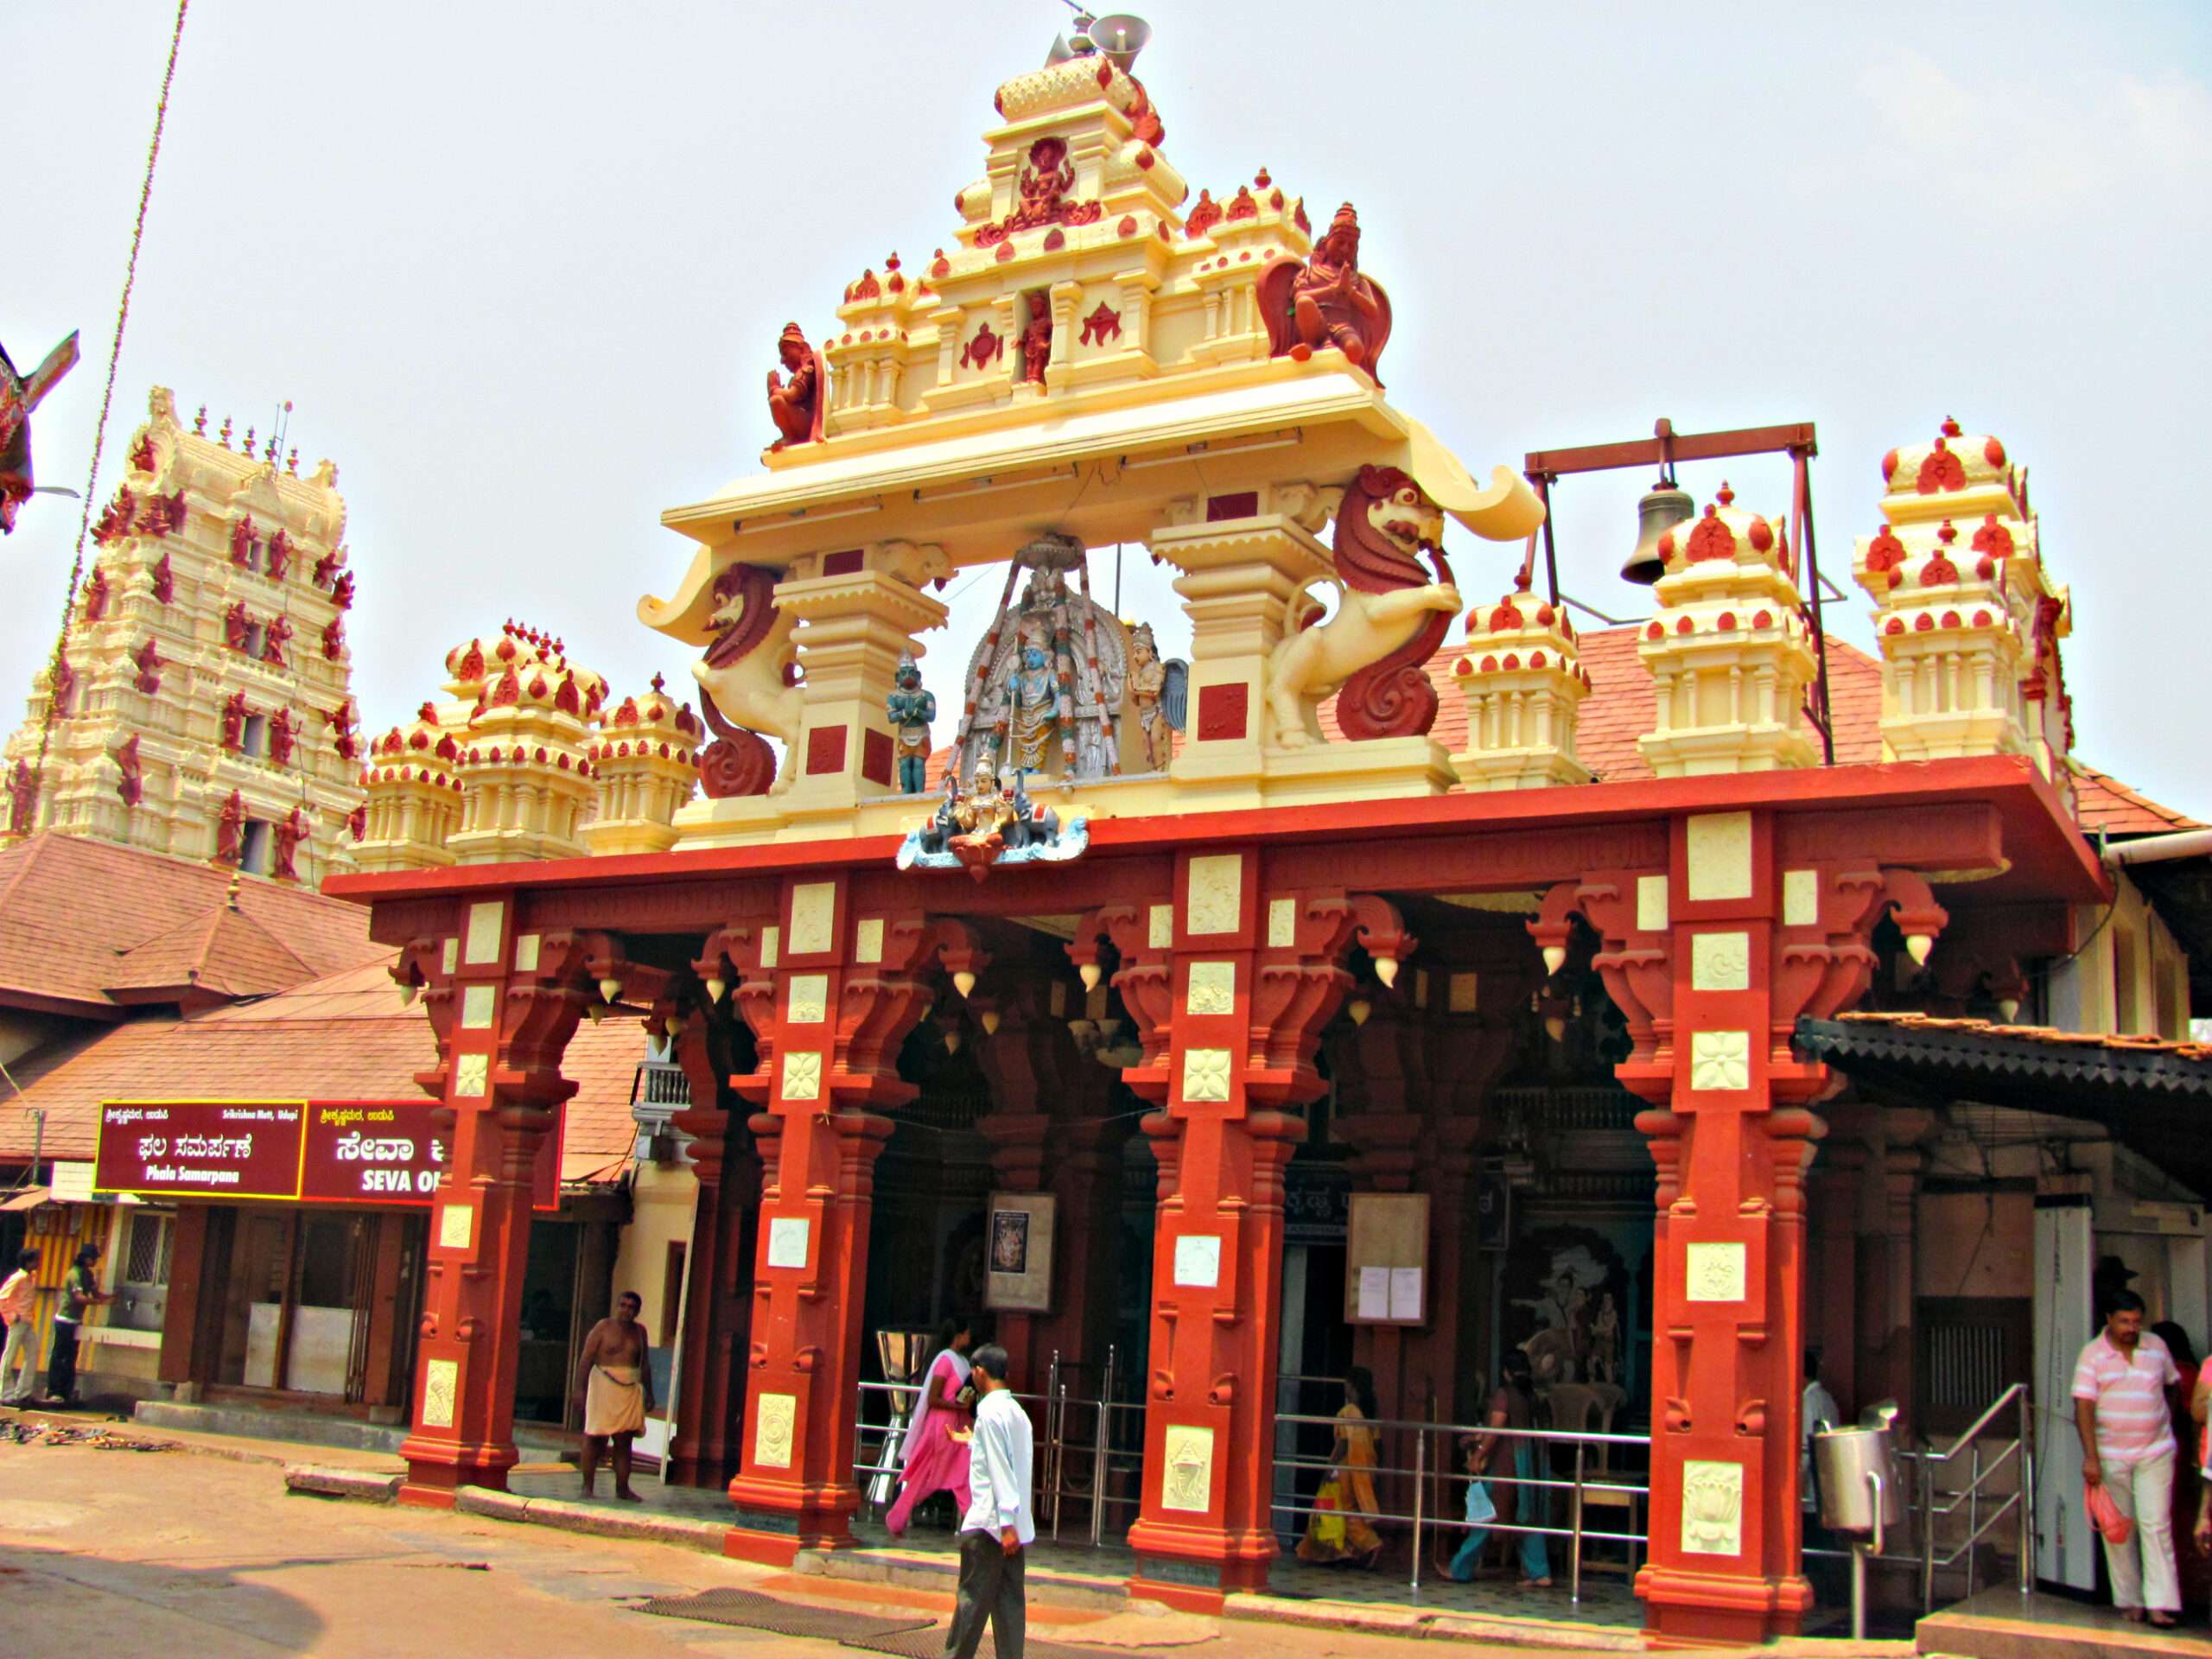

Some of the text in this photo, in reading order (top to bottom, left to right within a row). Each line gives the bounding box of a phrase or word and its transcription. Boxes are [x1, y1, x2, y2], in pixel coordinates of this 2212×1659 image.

[138, 1134, 252, 1160] ಫಲ ಸಮರ್ಪಣೆ
[337, 1131, 415, 1161] ಸೇವಾ
[145, 1165, 240, 1185] Phala Samarpana
[361, 1170, 412, 1192] SEVA
